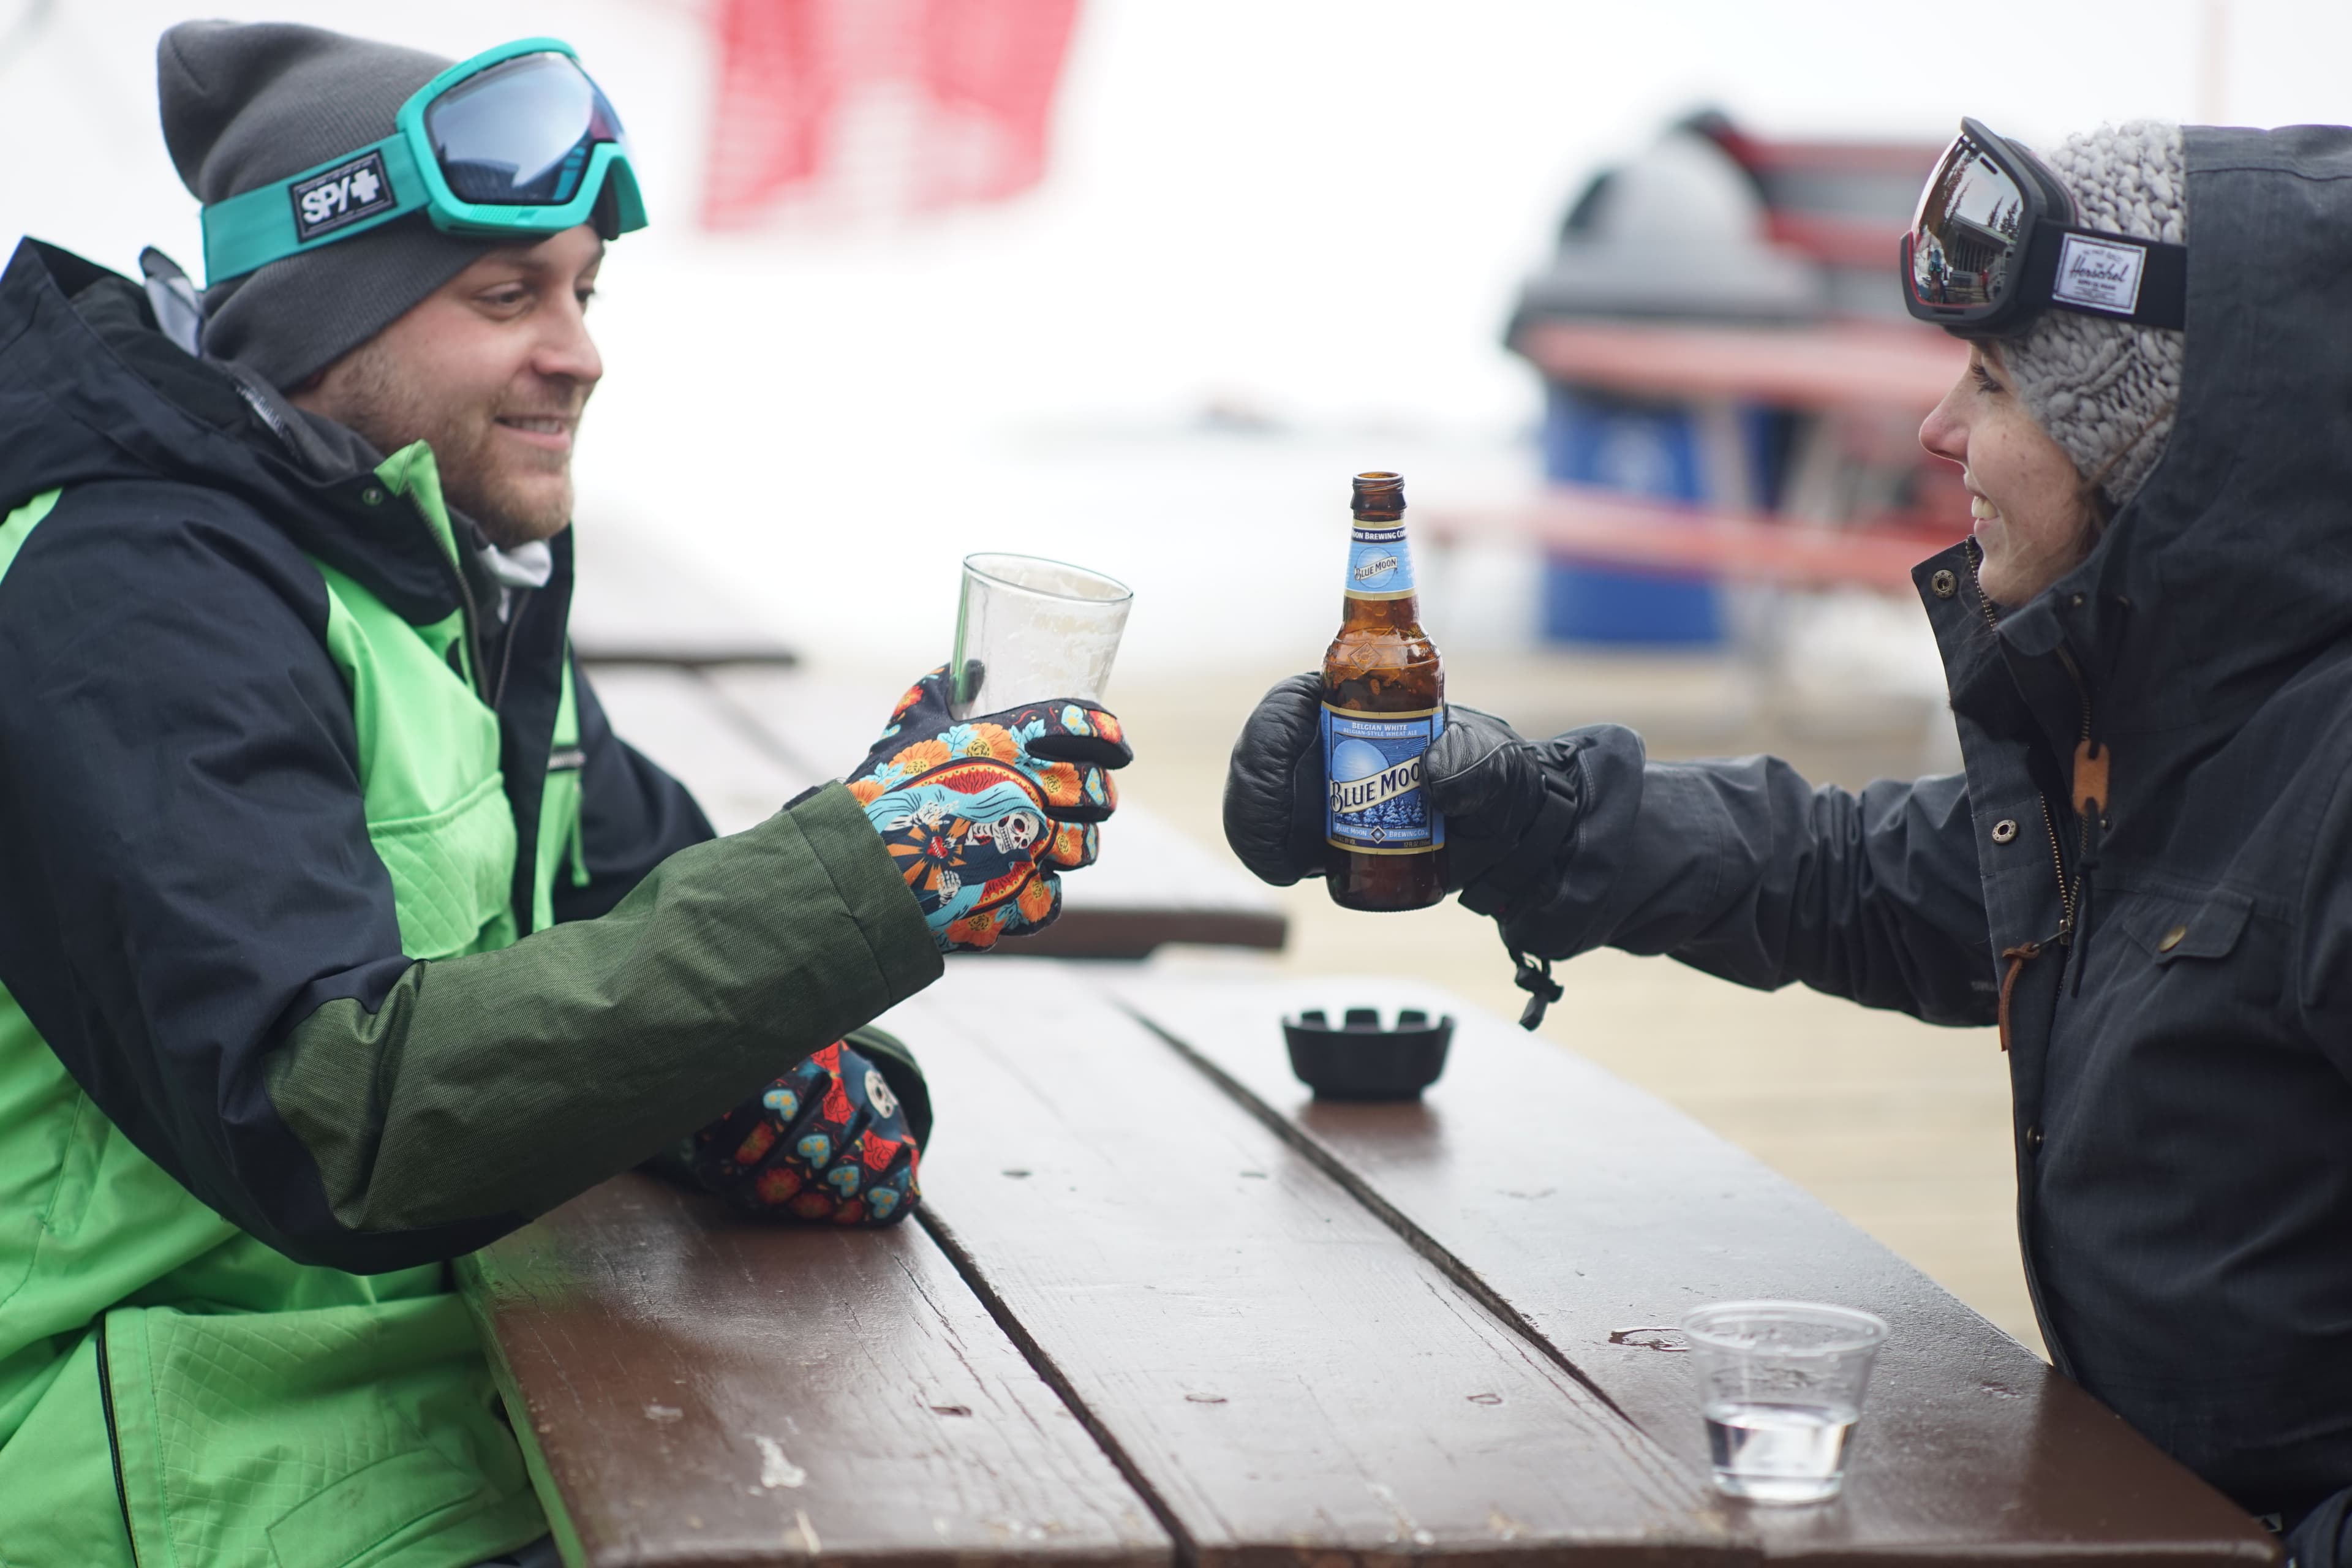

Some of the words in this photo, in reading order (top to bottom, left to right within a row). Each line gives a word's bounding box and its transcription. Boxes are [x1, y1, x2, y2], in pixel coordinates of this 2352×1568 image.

[301, 176, 350, 224] SPY
[2070, 255, 2130, 284] Herschel
[1355, 567, 1373, 581] BLUE
[1375, 558, 1396, 572] MOON
[1343, 727, 1384, 736] BELGIAN-STYLE
[1352, 722, 1382, 731] BELGIAN
[1330, 780, 1375, 813] BLUE
[1381, 763, 1419, 797] MOO
[1336, 823, 1349, 832] BLUE
[1351, 827, 1367, 836] MOON
